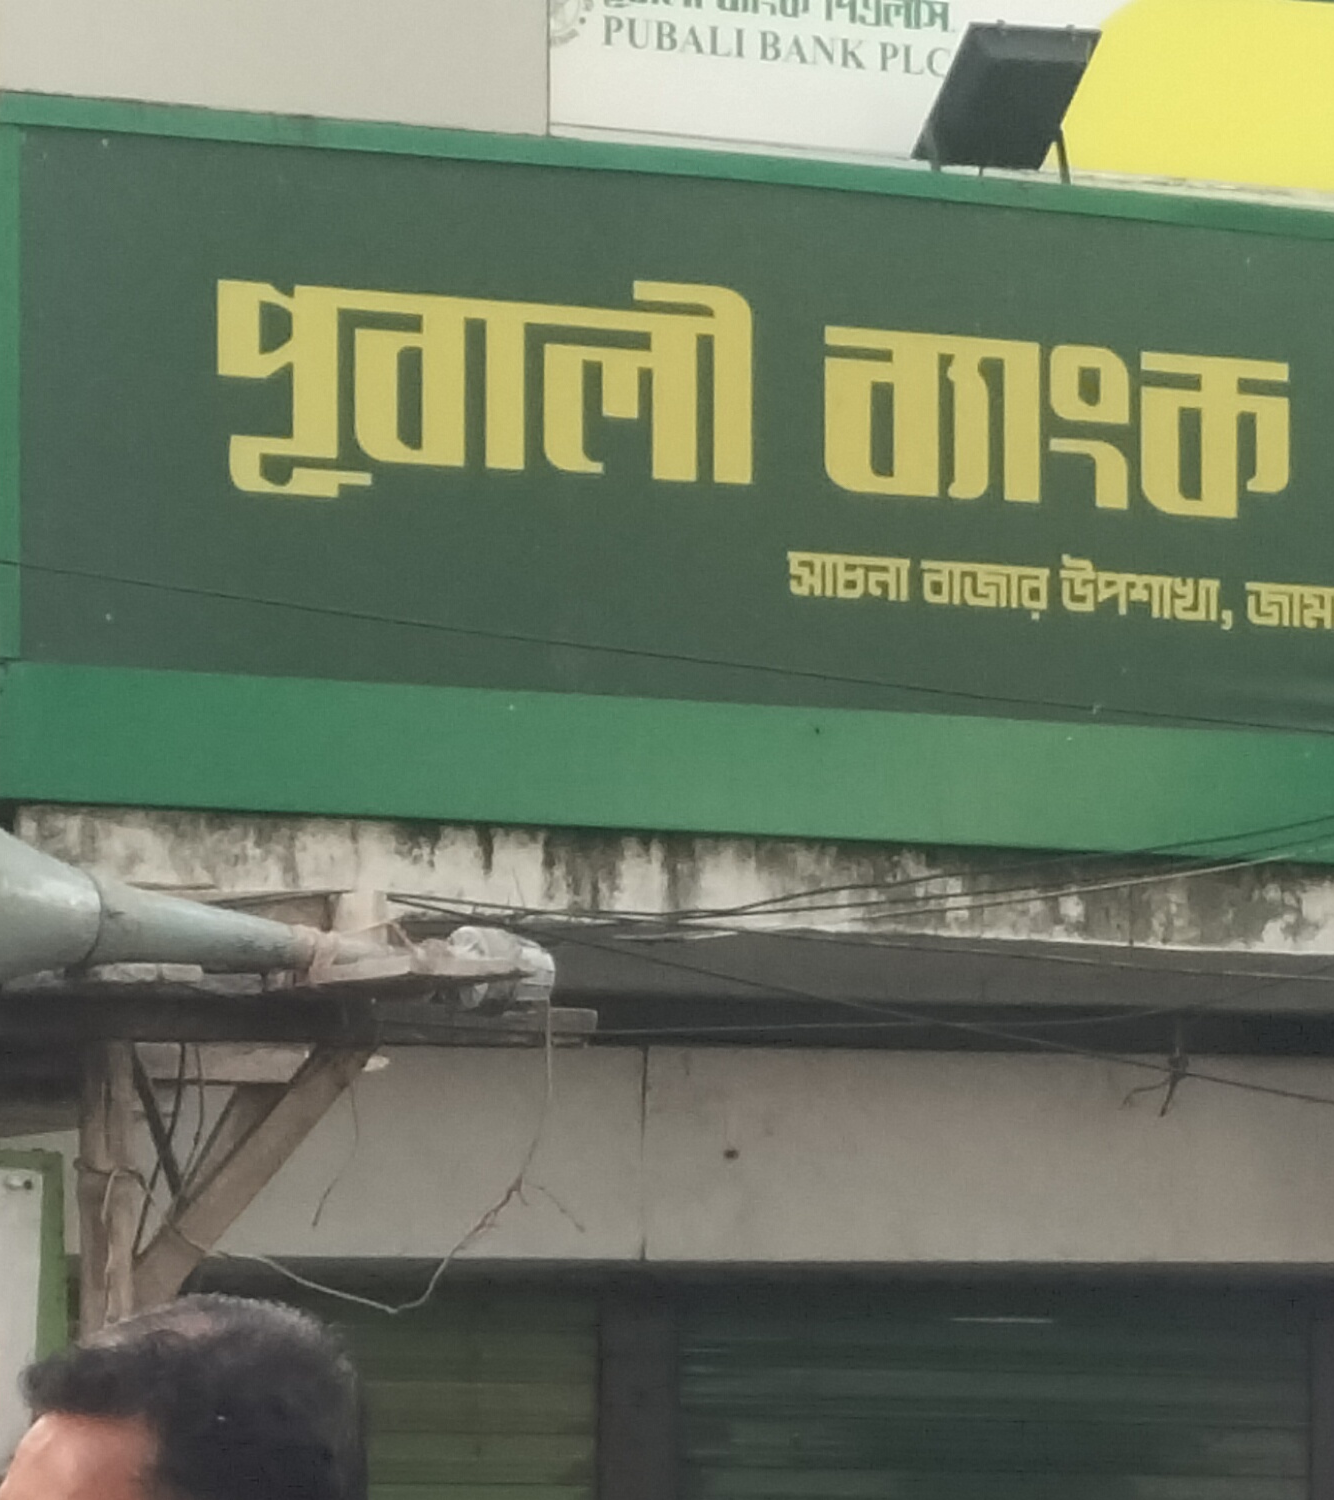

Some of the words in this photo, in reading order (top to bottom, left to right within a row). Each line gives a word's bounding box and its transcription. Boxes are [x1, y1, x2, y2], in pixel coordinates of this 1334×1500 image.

[603, 14, 745, 58] PUBALI
[759, 30, 866, 70] BANK
[216, 278, 753, 498] পূবালী
[824, 325, 1291, 520] ব্যাংক
[786, 551, 911, 602] সাচনা
[921, 560, 1050, 620] বাজার
[1059, 554, 1234, 631] উপশাখা,
